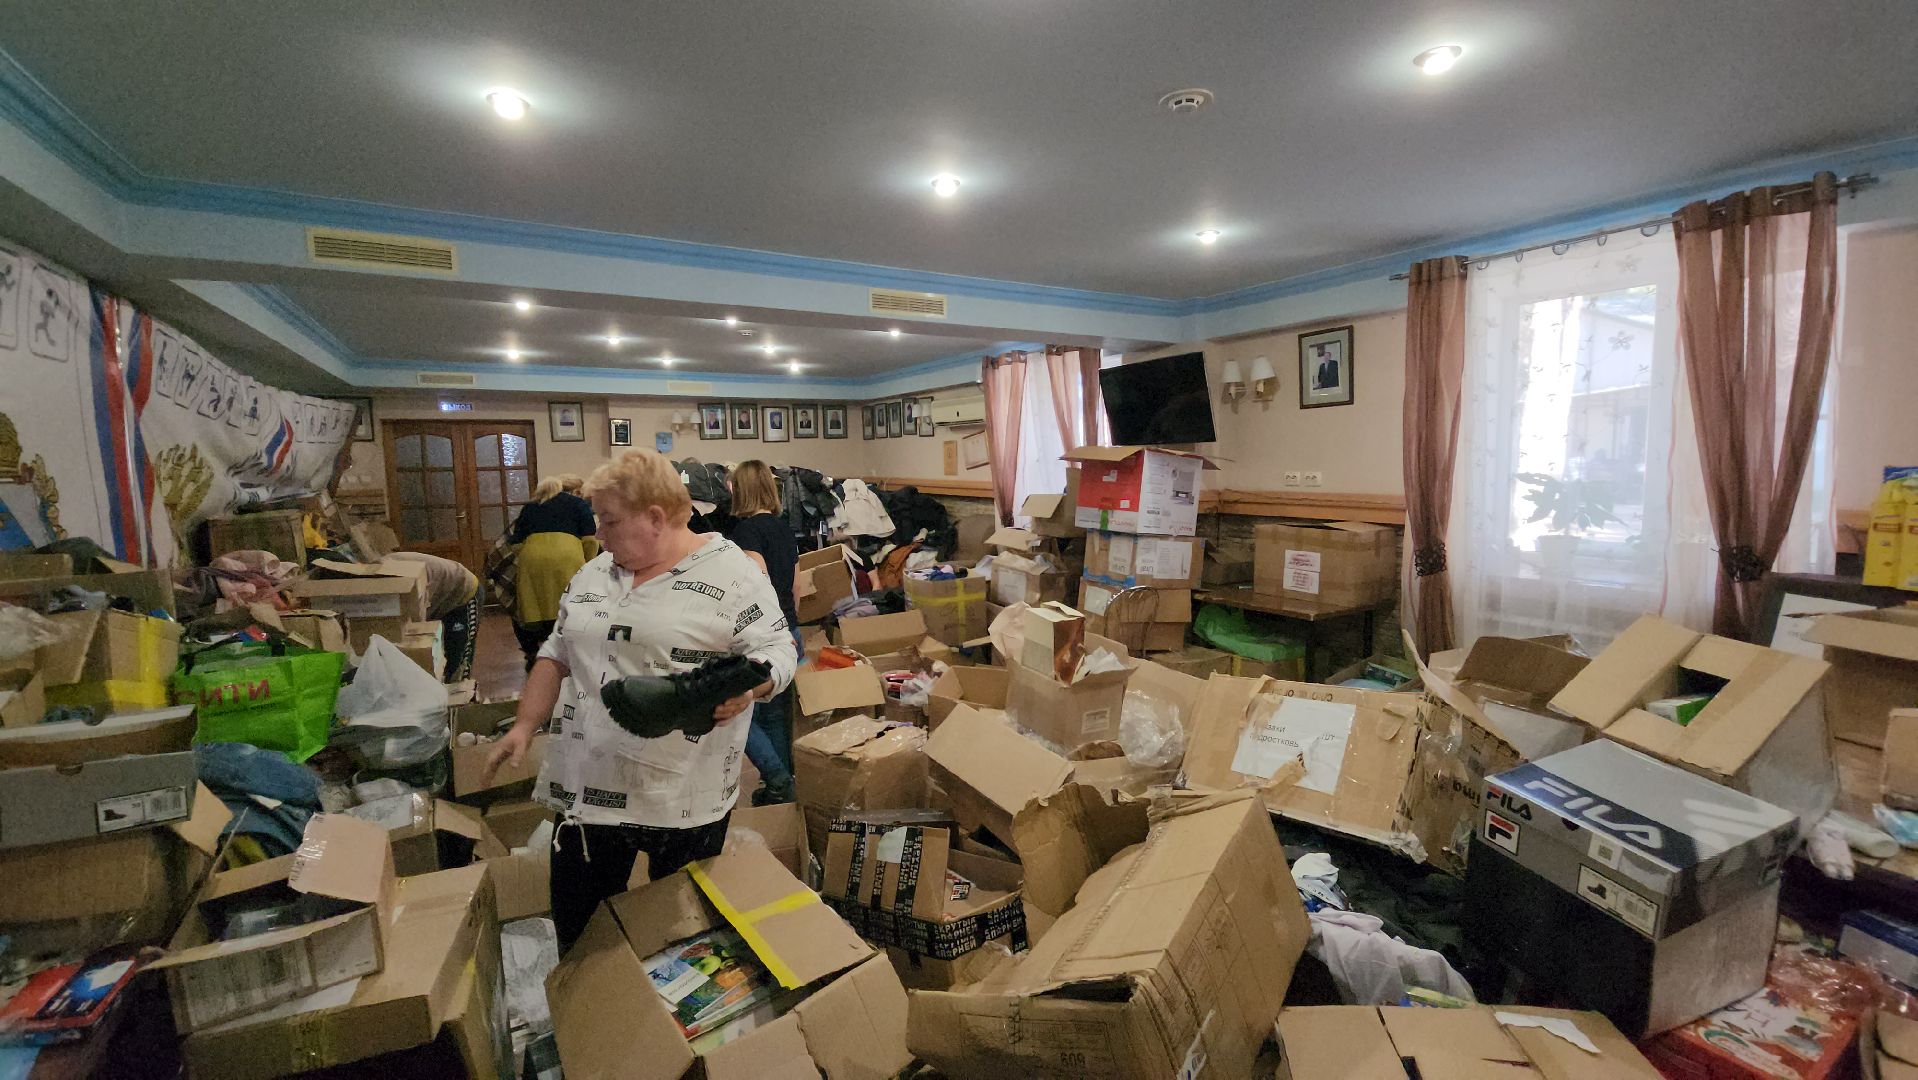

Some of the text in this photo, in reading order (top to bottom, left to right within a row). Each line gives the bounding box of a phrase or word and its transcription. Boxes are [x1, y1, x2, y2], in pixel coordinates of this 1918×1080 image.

[690, 582, 724, 600] RETURN
[1487, 785, 1532, 821] FILA
[1524, 777, 1663, 849] FILA
